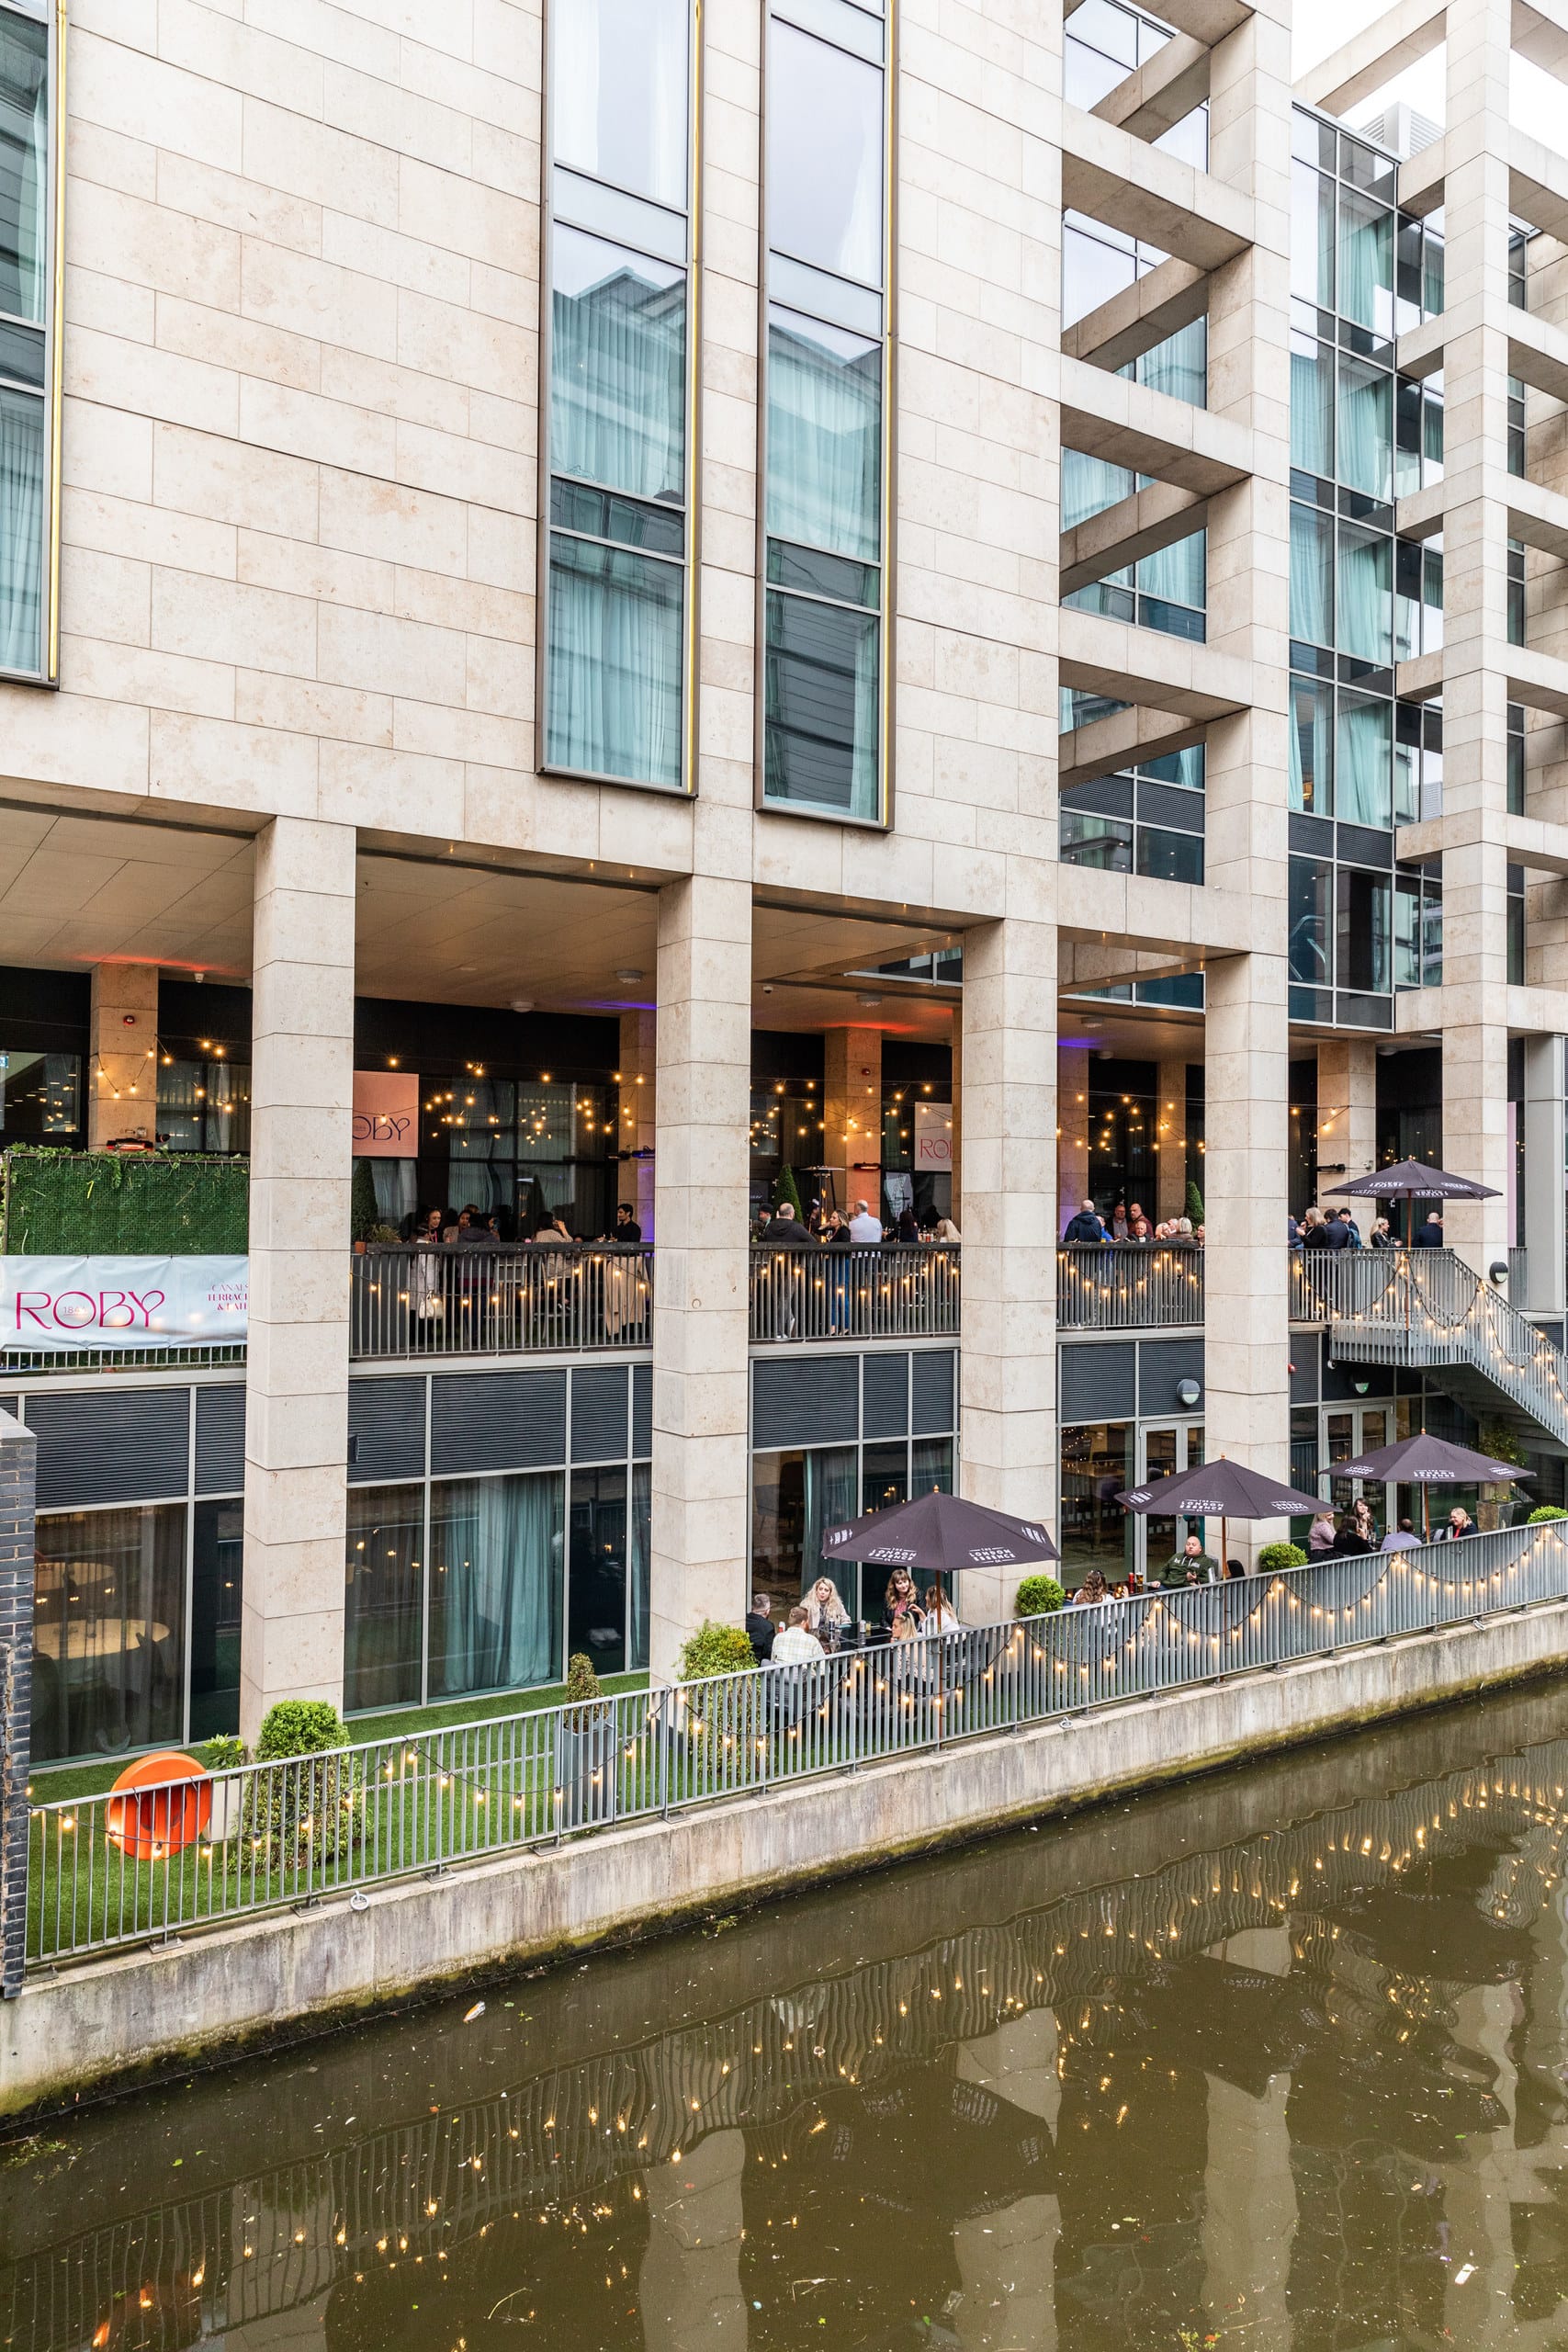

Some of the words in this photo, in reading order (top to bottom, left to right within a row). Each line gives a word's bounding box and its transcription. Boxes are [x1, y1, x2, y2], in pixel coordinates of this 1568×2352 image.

[352, 1115, 411, 1141] OBY
[16, 1290, 165, 1329] ROBY
[217, 1303, 224, 1311] &
[872, 1548, 917, 1557] LONDON
[968, 1548, 1012, 1557] LONDON
